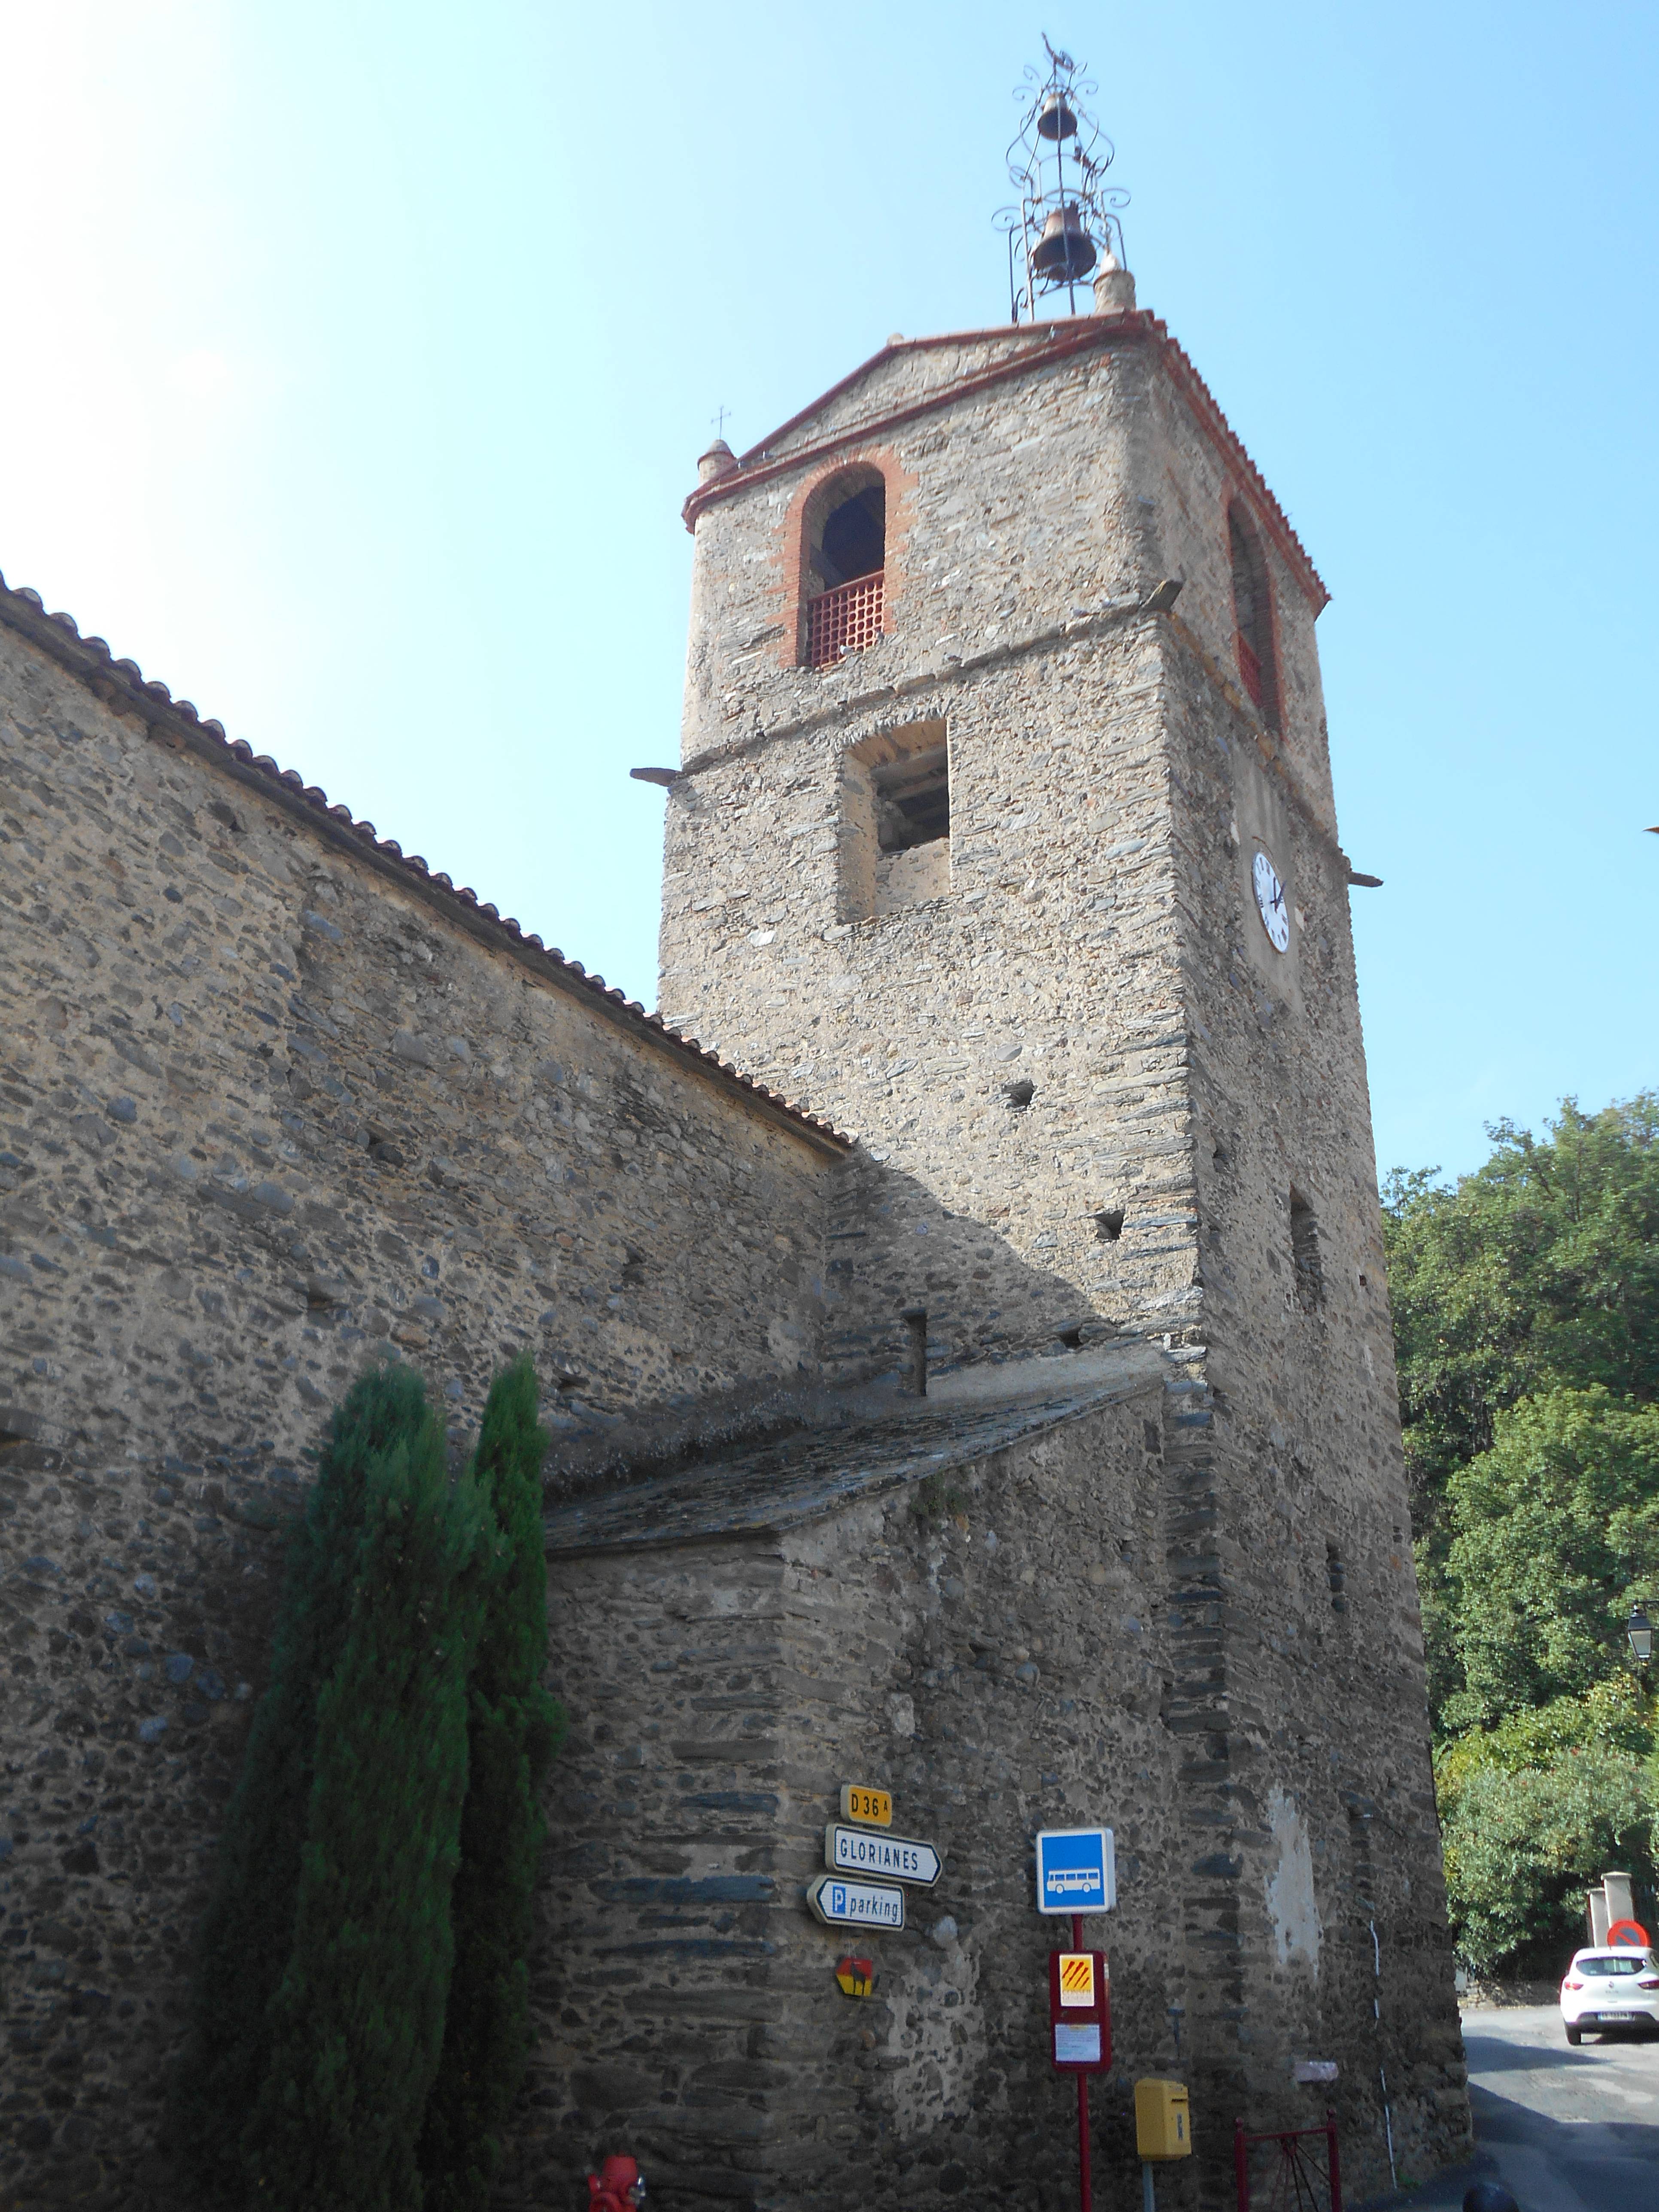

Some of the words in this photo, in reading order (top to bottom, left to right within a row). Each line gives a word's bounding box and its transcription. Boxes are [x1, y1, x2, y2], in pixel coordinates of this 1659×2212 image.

[851, 1793, 858, 1812] D
[863, 1796, 879, 1817] 36
[883, 1800, 888, 1812] A
[840, 1838, 918, 1871] GLORIANES
[834, 1889, 844, 1911] P
[850, 1896, 898, 1923] parking
